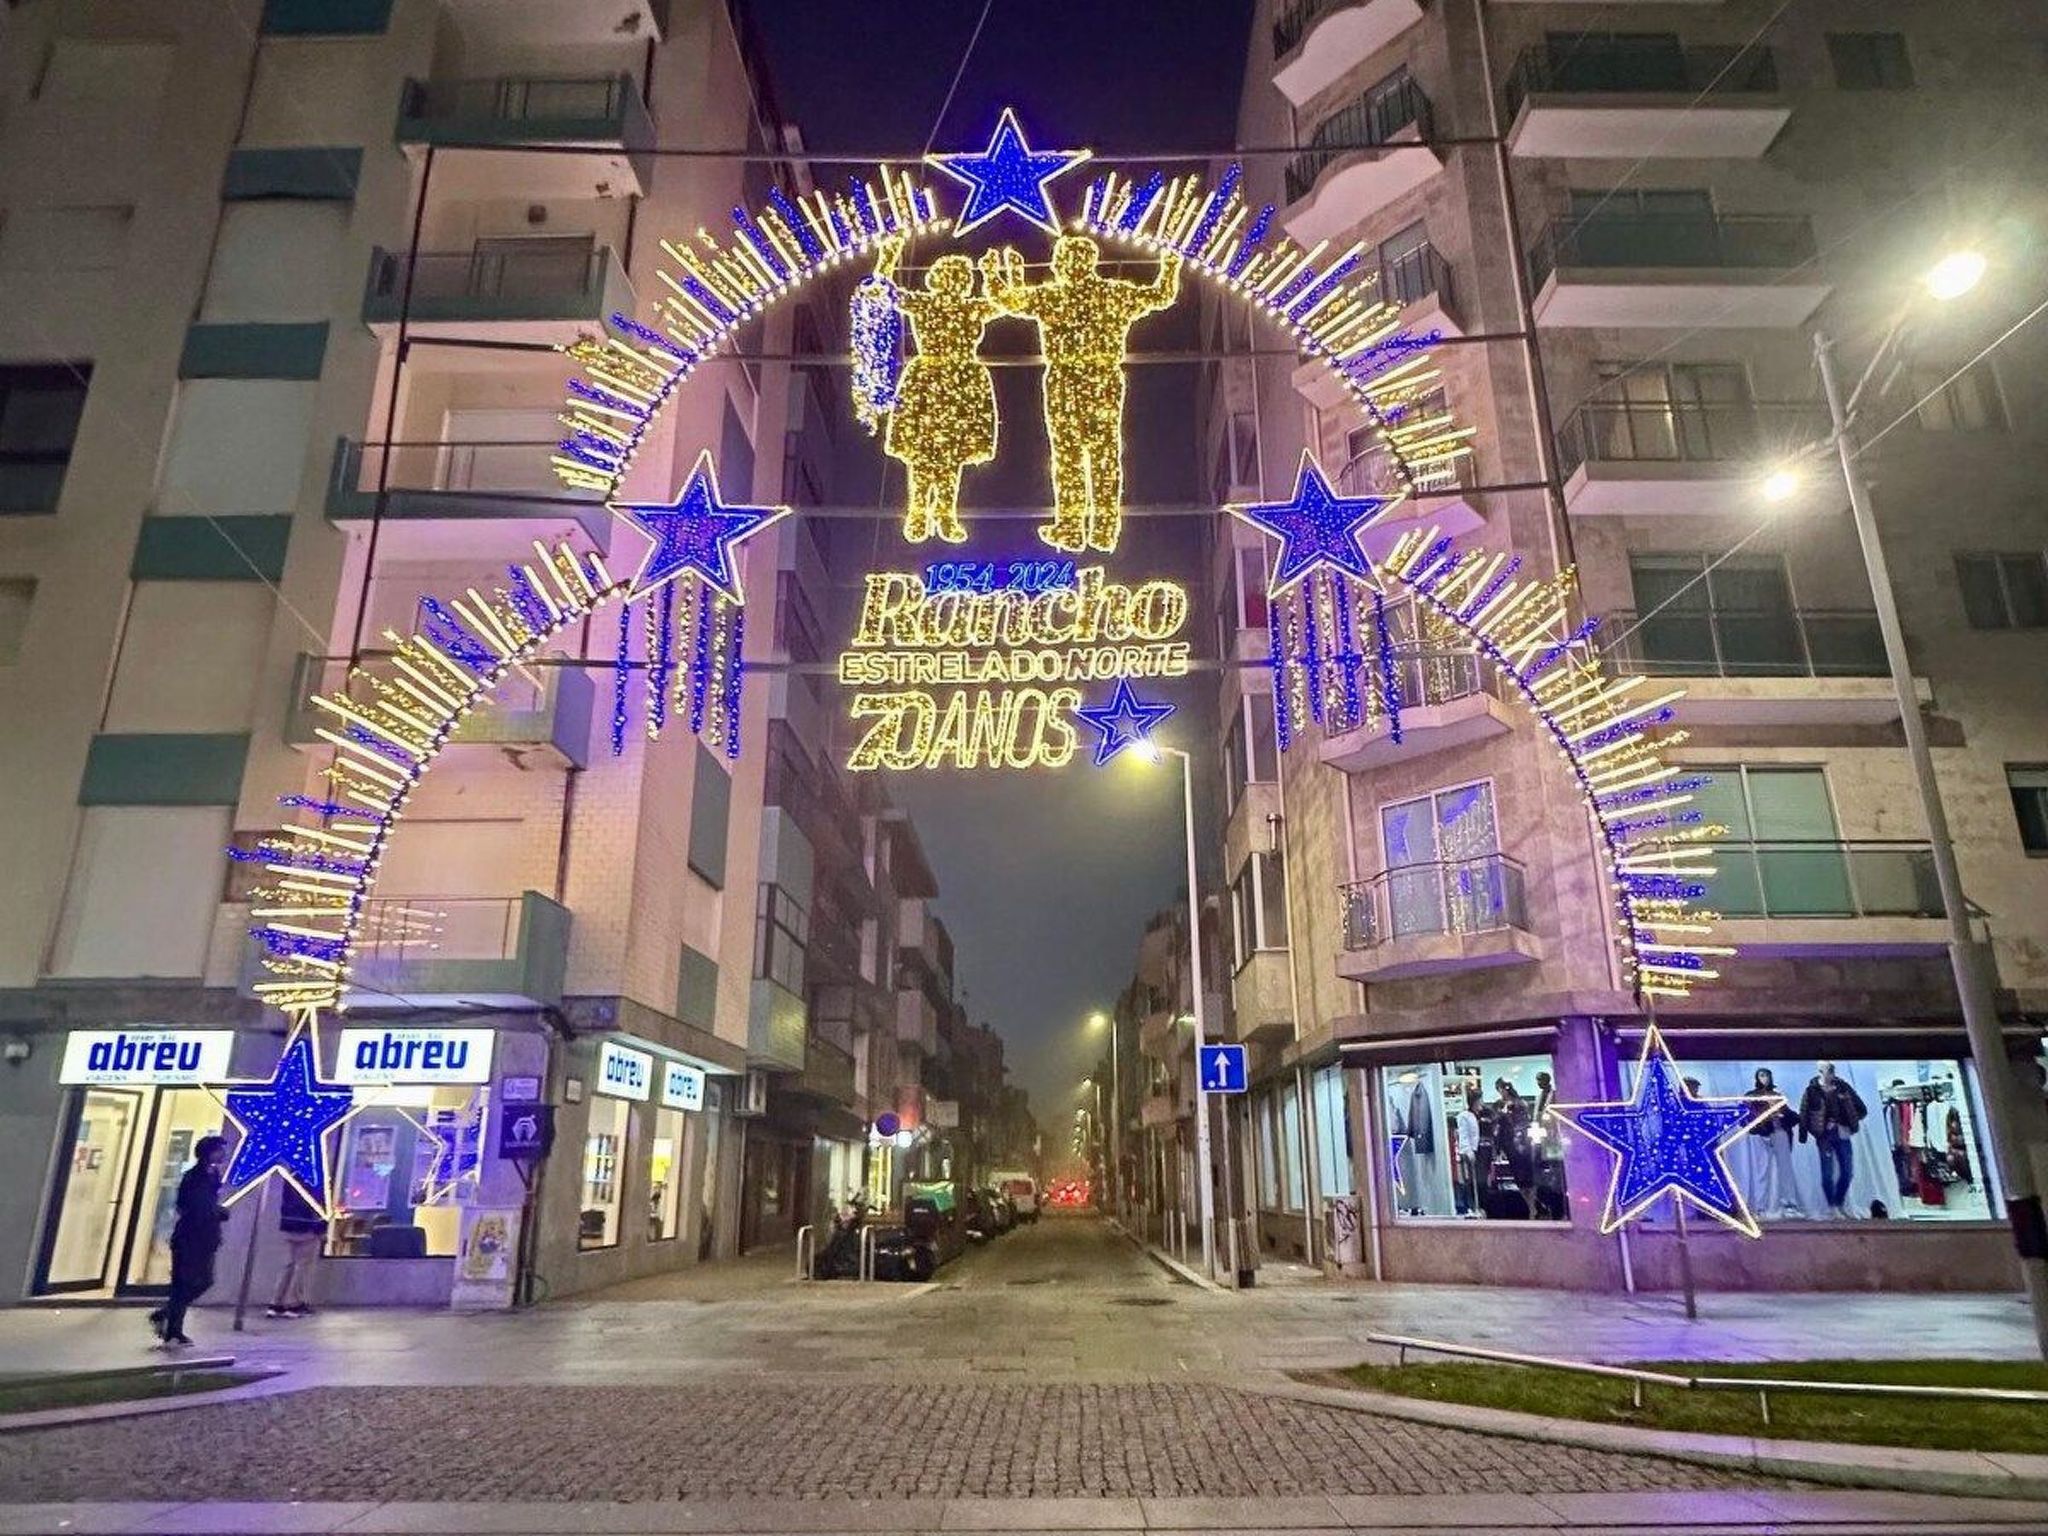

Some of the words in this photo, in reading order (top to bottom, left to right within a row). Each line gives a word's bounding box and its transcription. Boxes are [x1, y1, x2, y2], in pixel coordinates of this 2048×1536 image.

[926, 562, 995, 593] 1954
[1007, 561, 1074, 592] 2024
[852, 567, 1187, 647] Rancho
[1065, 642, 1190, 682] NORTE
[925, 688, 1082, 769] ANOS
[88, 1035, 202, 1071] abreu
[355, 1033, 469, 1069] abreu
[607, 1051, 645, 1087] abreu
